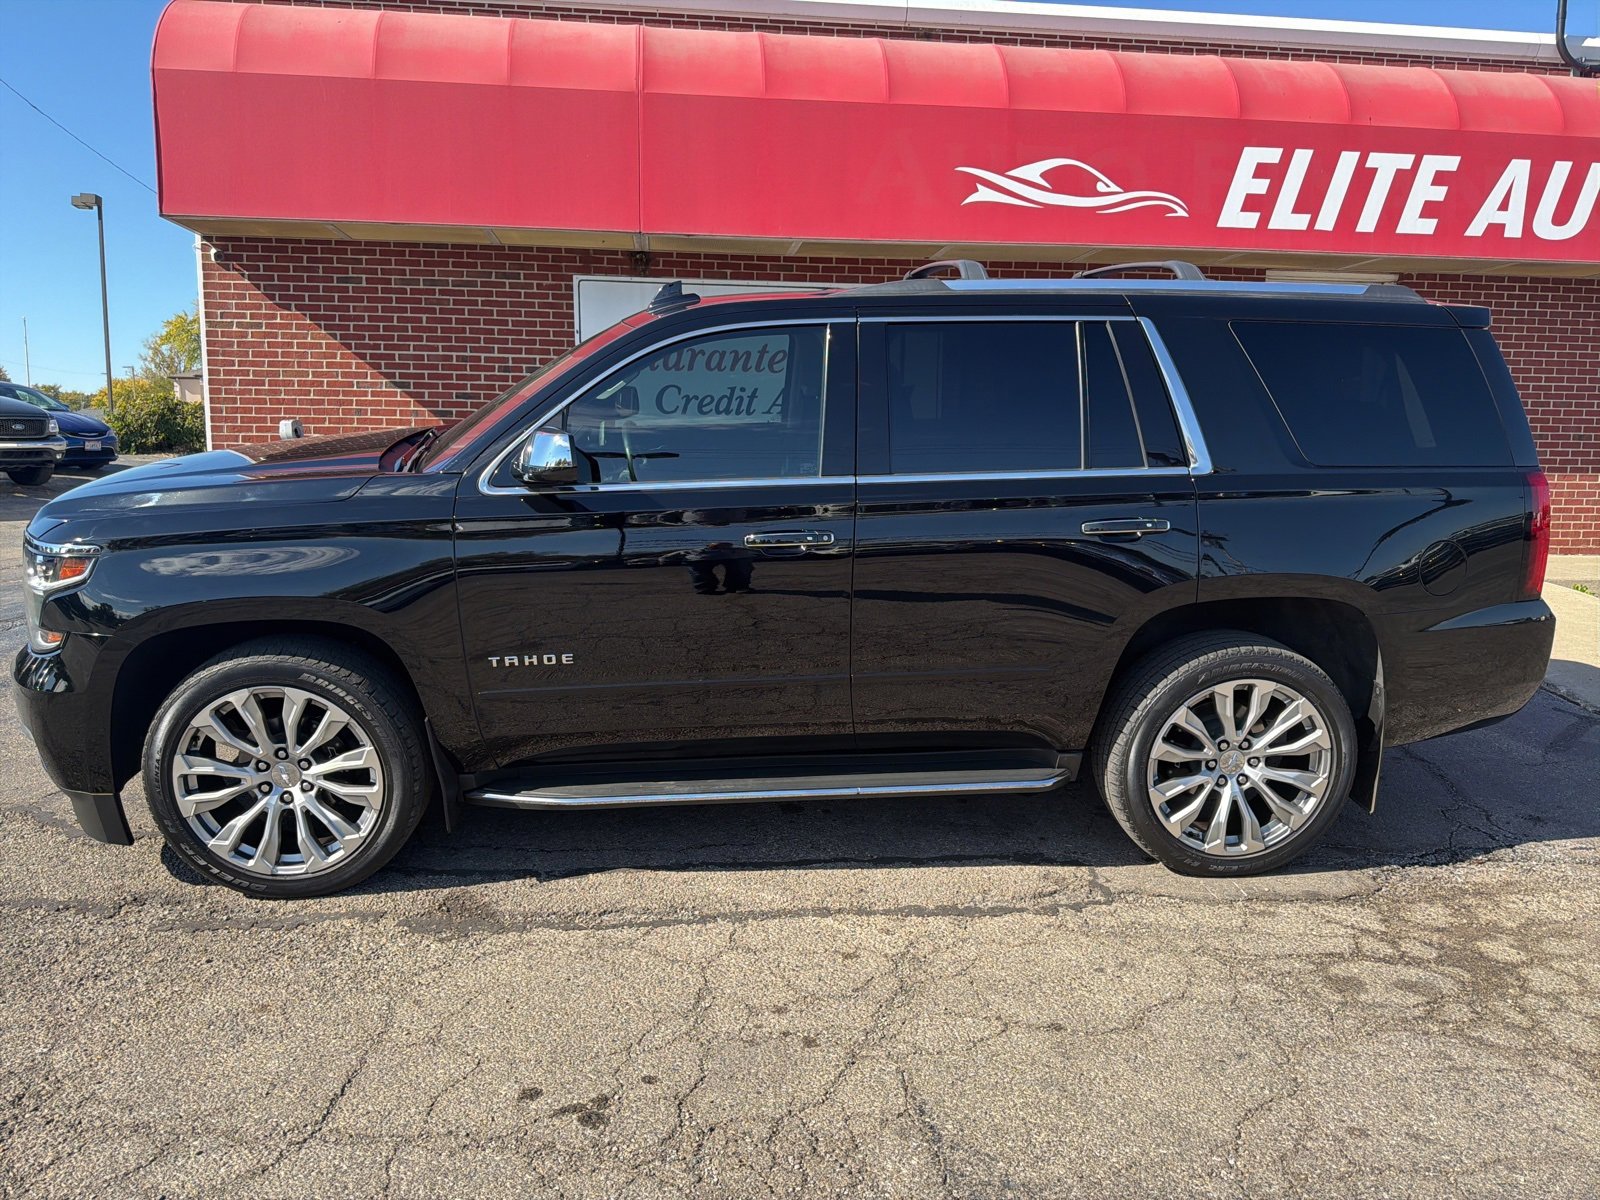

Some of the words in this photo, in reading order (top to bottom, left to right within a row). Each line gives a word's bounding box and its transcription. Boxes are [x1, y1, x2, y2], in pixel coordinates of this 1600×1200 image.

[1216, 146, 1461, 235] ELITE
[1463, 158, 1600, 241] AU
[655, 384, 759, 416] Credit
[487, 653, 575, 668] TAHOE
